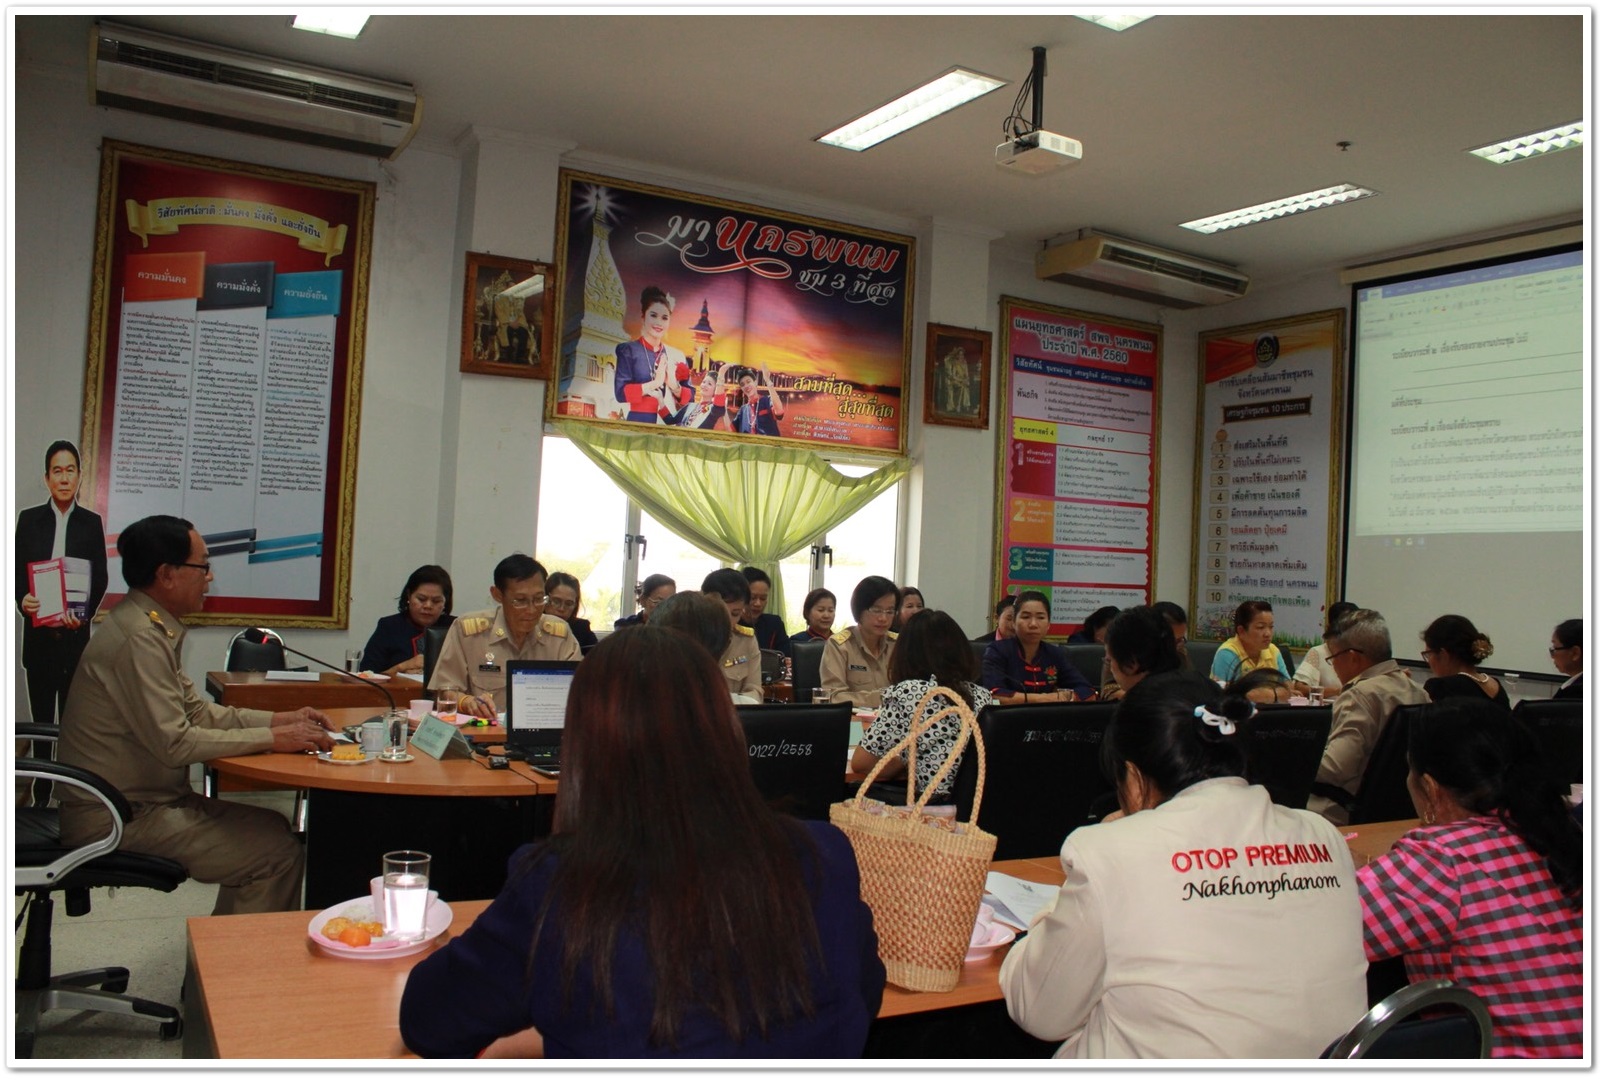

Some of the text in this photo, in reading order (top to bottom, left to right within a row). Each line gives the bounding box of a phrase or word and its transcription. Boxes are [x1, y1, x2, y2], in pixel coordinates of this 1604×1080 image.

[157, 202, 216, 220] วิสัยทัศน์ชาติ
[223, 201, 250, 218] มั่นคง
[253, 204, 277, 223] มั่งคั่ง
[281, 217, 321, 239] และยั่งยืน
[635, 215, 900, 279] มา นครพนม
[137, 268, 187, 284] ความมั่นคง
[216, 278, 262, 294] ความมั่งคั่ง
[284, 286, 328, 301] ความยั่งยืน
[795, 265, 900, 306] ชม 3 ที่สุด
[1014, 318, 1152, 351] แผนยุทธศาสตร์ สพจ. นครพนม
[1042, 338, 1128, 362] ประจำปี พ.ศ. 2560
[1016, 356, 1043, 370] วิสัยทัศน์
[794, 373, 866, 399] สามที่สุด...
[1219, 369, 1313, 388] การขับเคลื่อนสัมมาชีพชุมชน
[1017, 387, 1038, 400] พันธกิจ
[1238, 385, 1291, 398] จังหวัดนครพนม
[838, 396, 894, 422] สู่สุขที่สุด
[1226, 406, 1269, 418] เศรษฐกิจชุมชน
[1282, 402, 1305, 411] ประการ
[1019, 425, 1048, 437] ยุทธศาสตร์
[1087, 435, 1106, 444] กลยุทธ์
[1219, 434, 1288, 452] 1 ส่งเสริมในพื้นที่ดี
[1014, 442, 1024, 466] 1
[1218, 451, 1302, 469] 2 ปรับในพื้นที่ไม่เหมาะ
[1217, 476, 1223, 485] 3
[1217, 488, 1300, 501] 4 เพื่อค้าขาย เน้นของดี
[1013, 500, 1025, 522] 2
[1216, 506, 1307, 520] 5 มีการลดต้นทุนการผลิต
[1215, 526, 1221, 535] 6
[1215, 540, 1279, 554] 7 หาวิธีเพิ่มมูลค่า
[1010, 549, 1023, 571] 3
[1214, 559, 1220, 567] 8
[1214, 574, 1220, 583] 9
[1260, 577, 1284, 587] Brand
[1286, 579, 1319, 588] นครพนม
[1211, 592, 1221, 602] 10
[749, 739, 813, 758] 0122/2558
[1172, 843, 1334, 873] OTOP PREMIUM
[1182, 873, 1341, 901] Nakhonphanom
